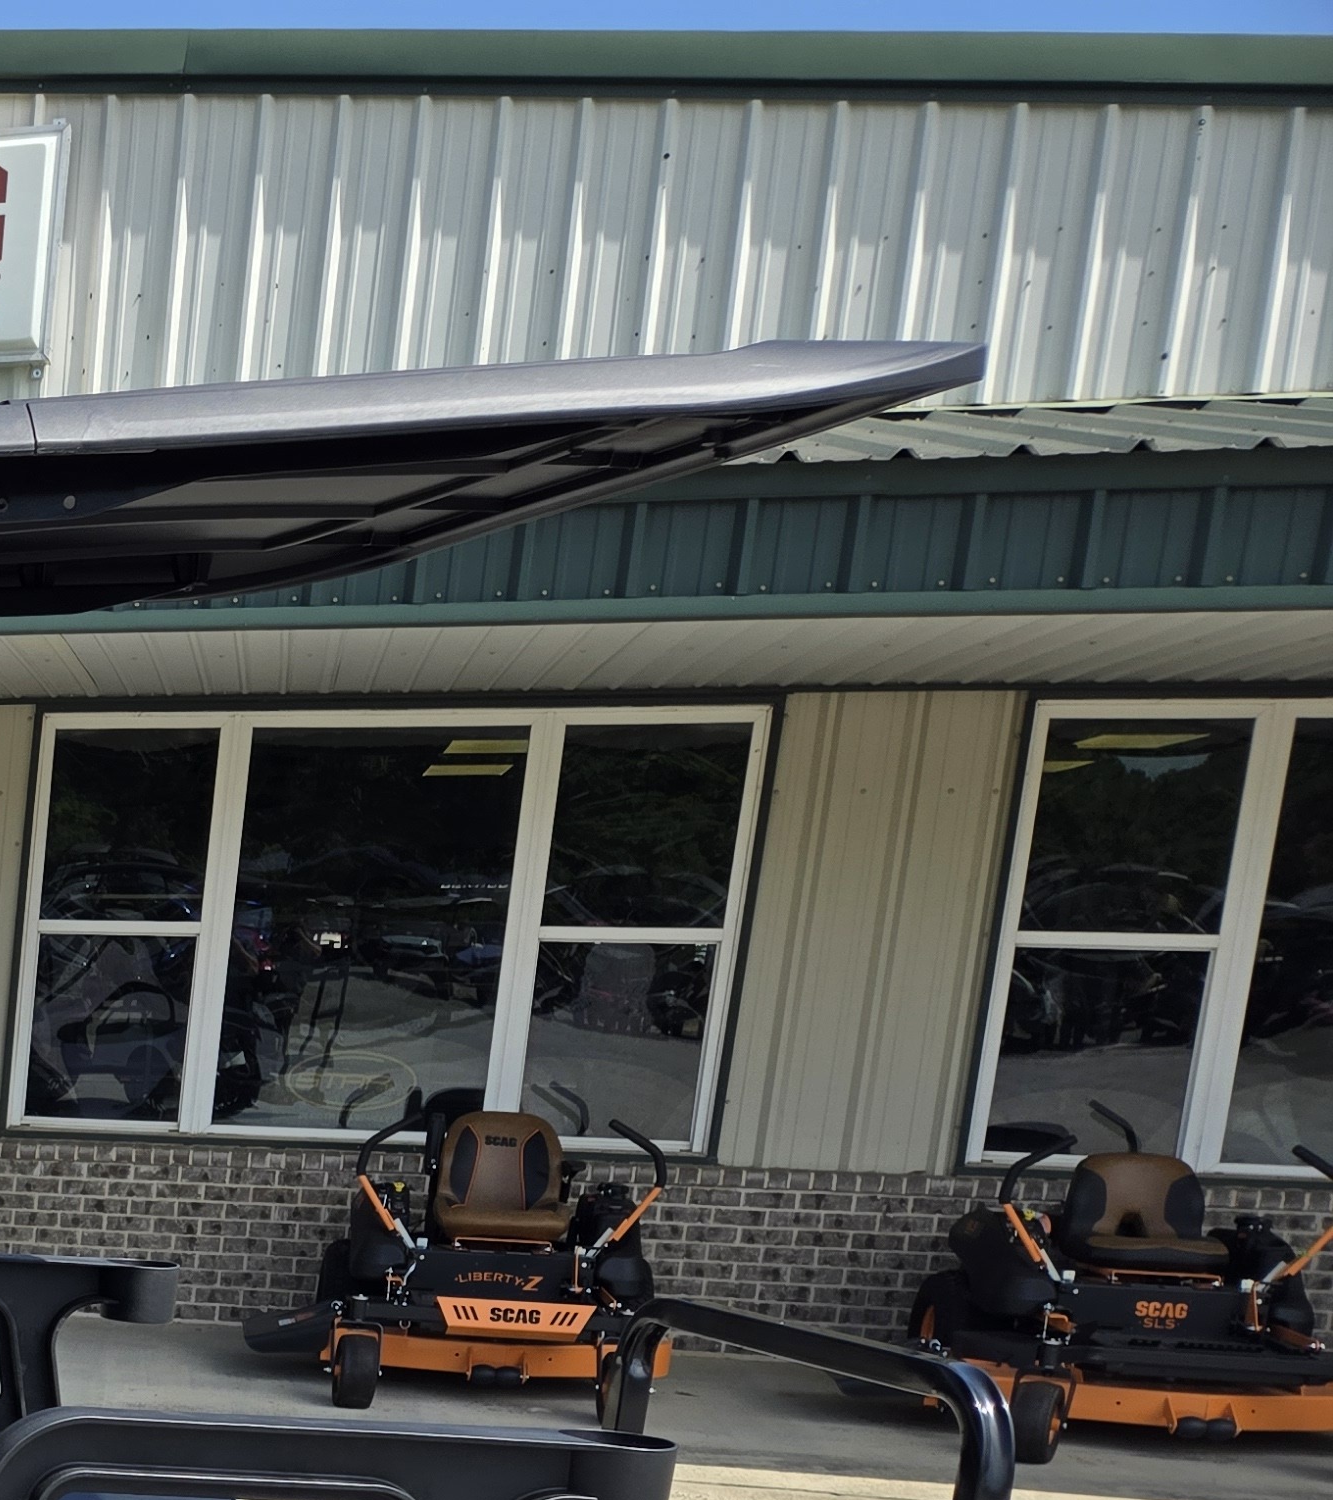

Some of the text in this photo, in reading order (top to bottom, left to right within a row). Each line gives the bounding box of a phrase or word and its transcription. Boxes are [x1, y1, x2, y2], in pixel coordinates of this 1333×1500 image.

[485, 1135, 518, 1148] SCAG
[489, 1307, 541, 1325] SCAG
[1135, 1300, 1189, 1319] SCAG
[1143, 1318, 1175, 1329] SLS
